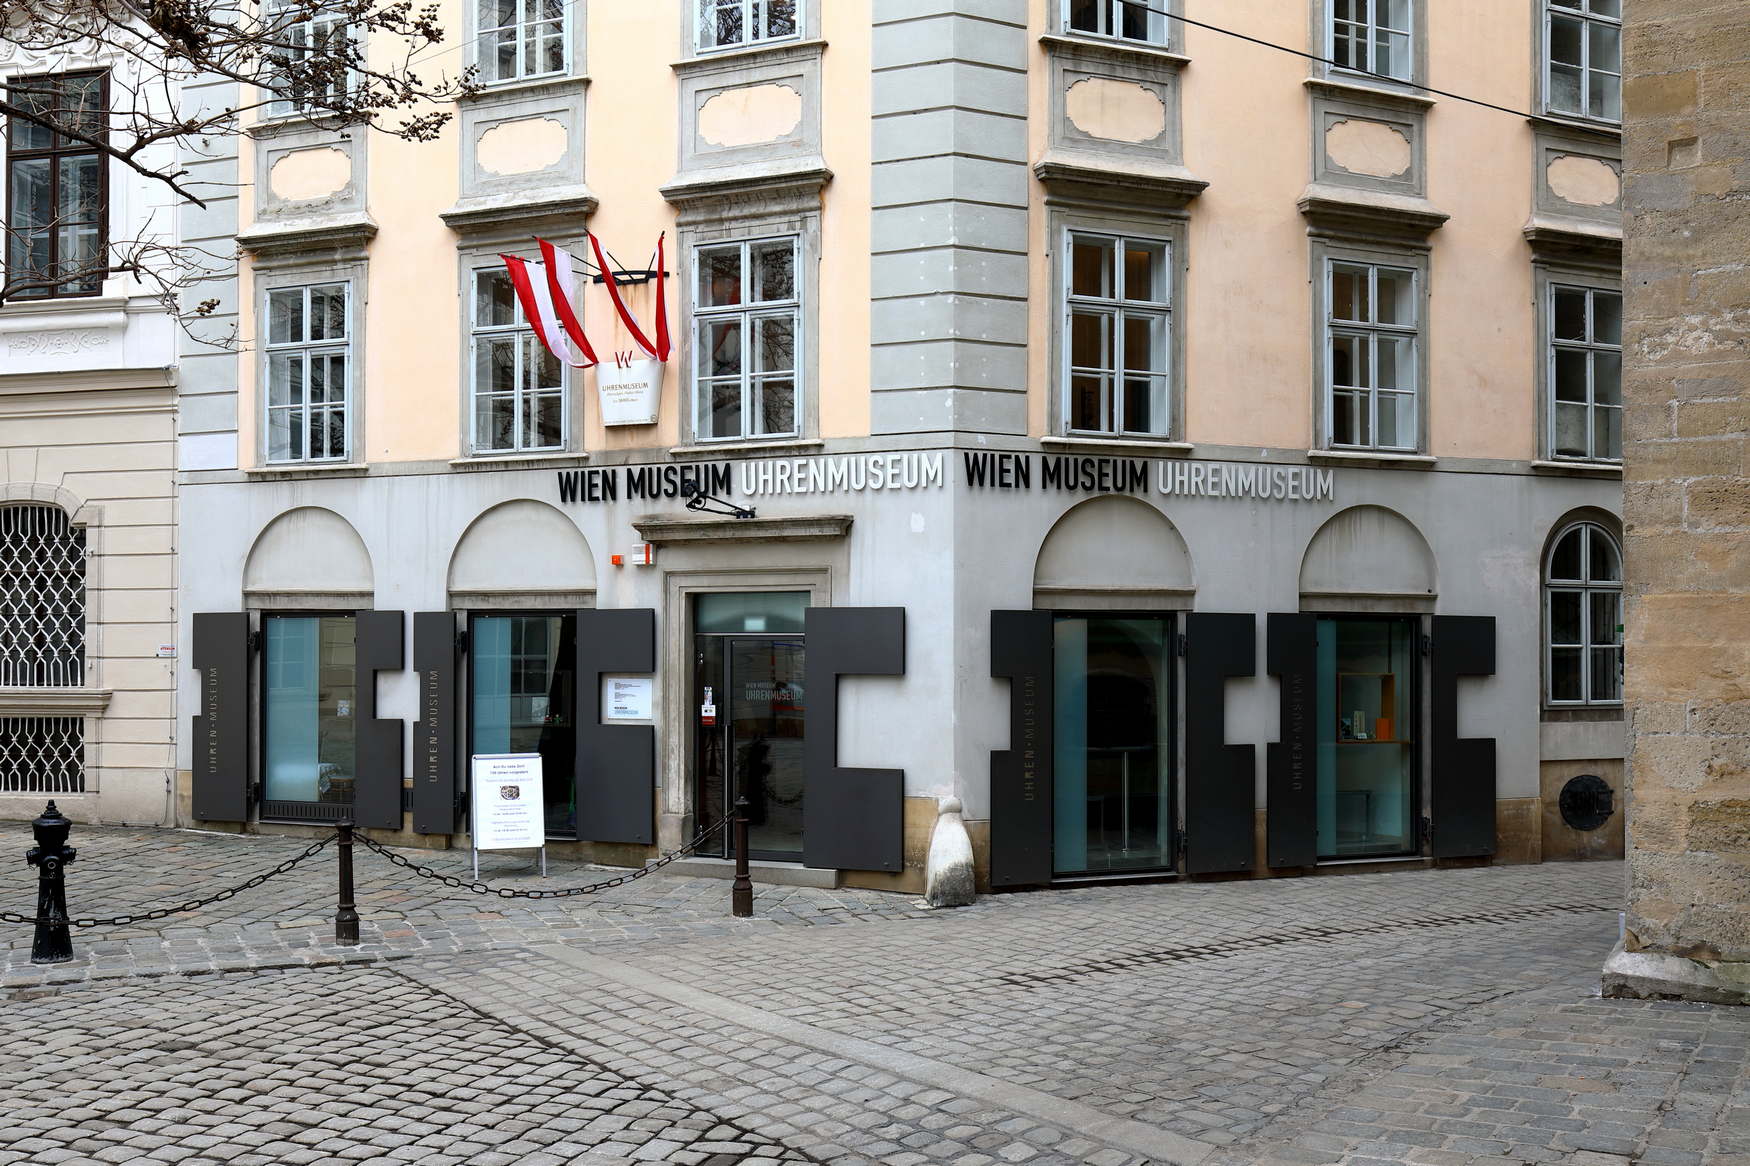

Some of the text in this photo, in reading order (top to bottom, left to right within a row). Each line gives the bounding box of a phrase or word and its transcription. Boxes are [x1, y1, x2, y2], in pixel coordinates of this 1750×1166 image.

[602, 382, 649, 392] UHRENMUSEUM
[557, 452, 944, 503] WIEN MUSEUM UHRENMUSEUM
[963, 452, 1335, 501] WIEN MUSEUM UHRENMUSEUM
